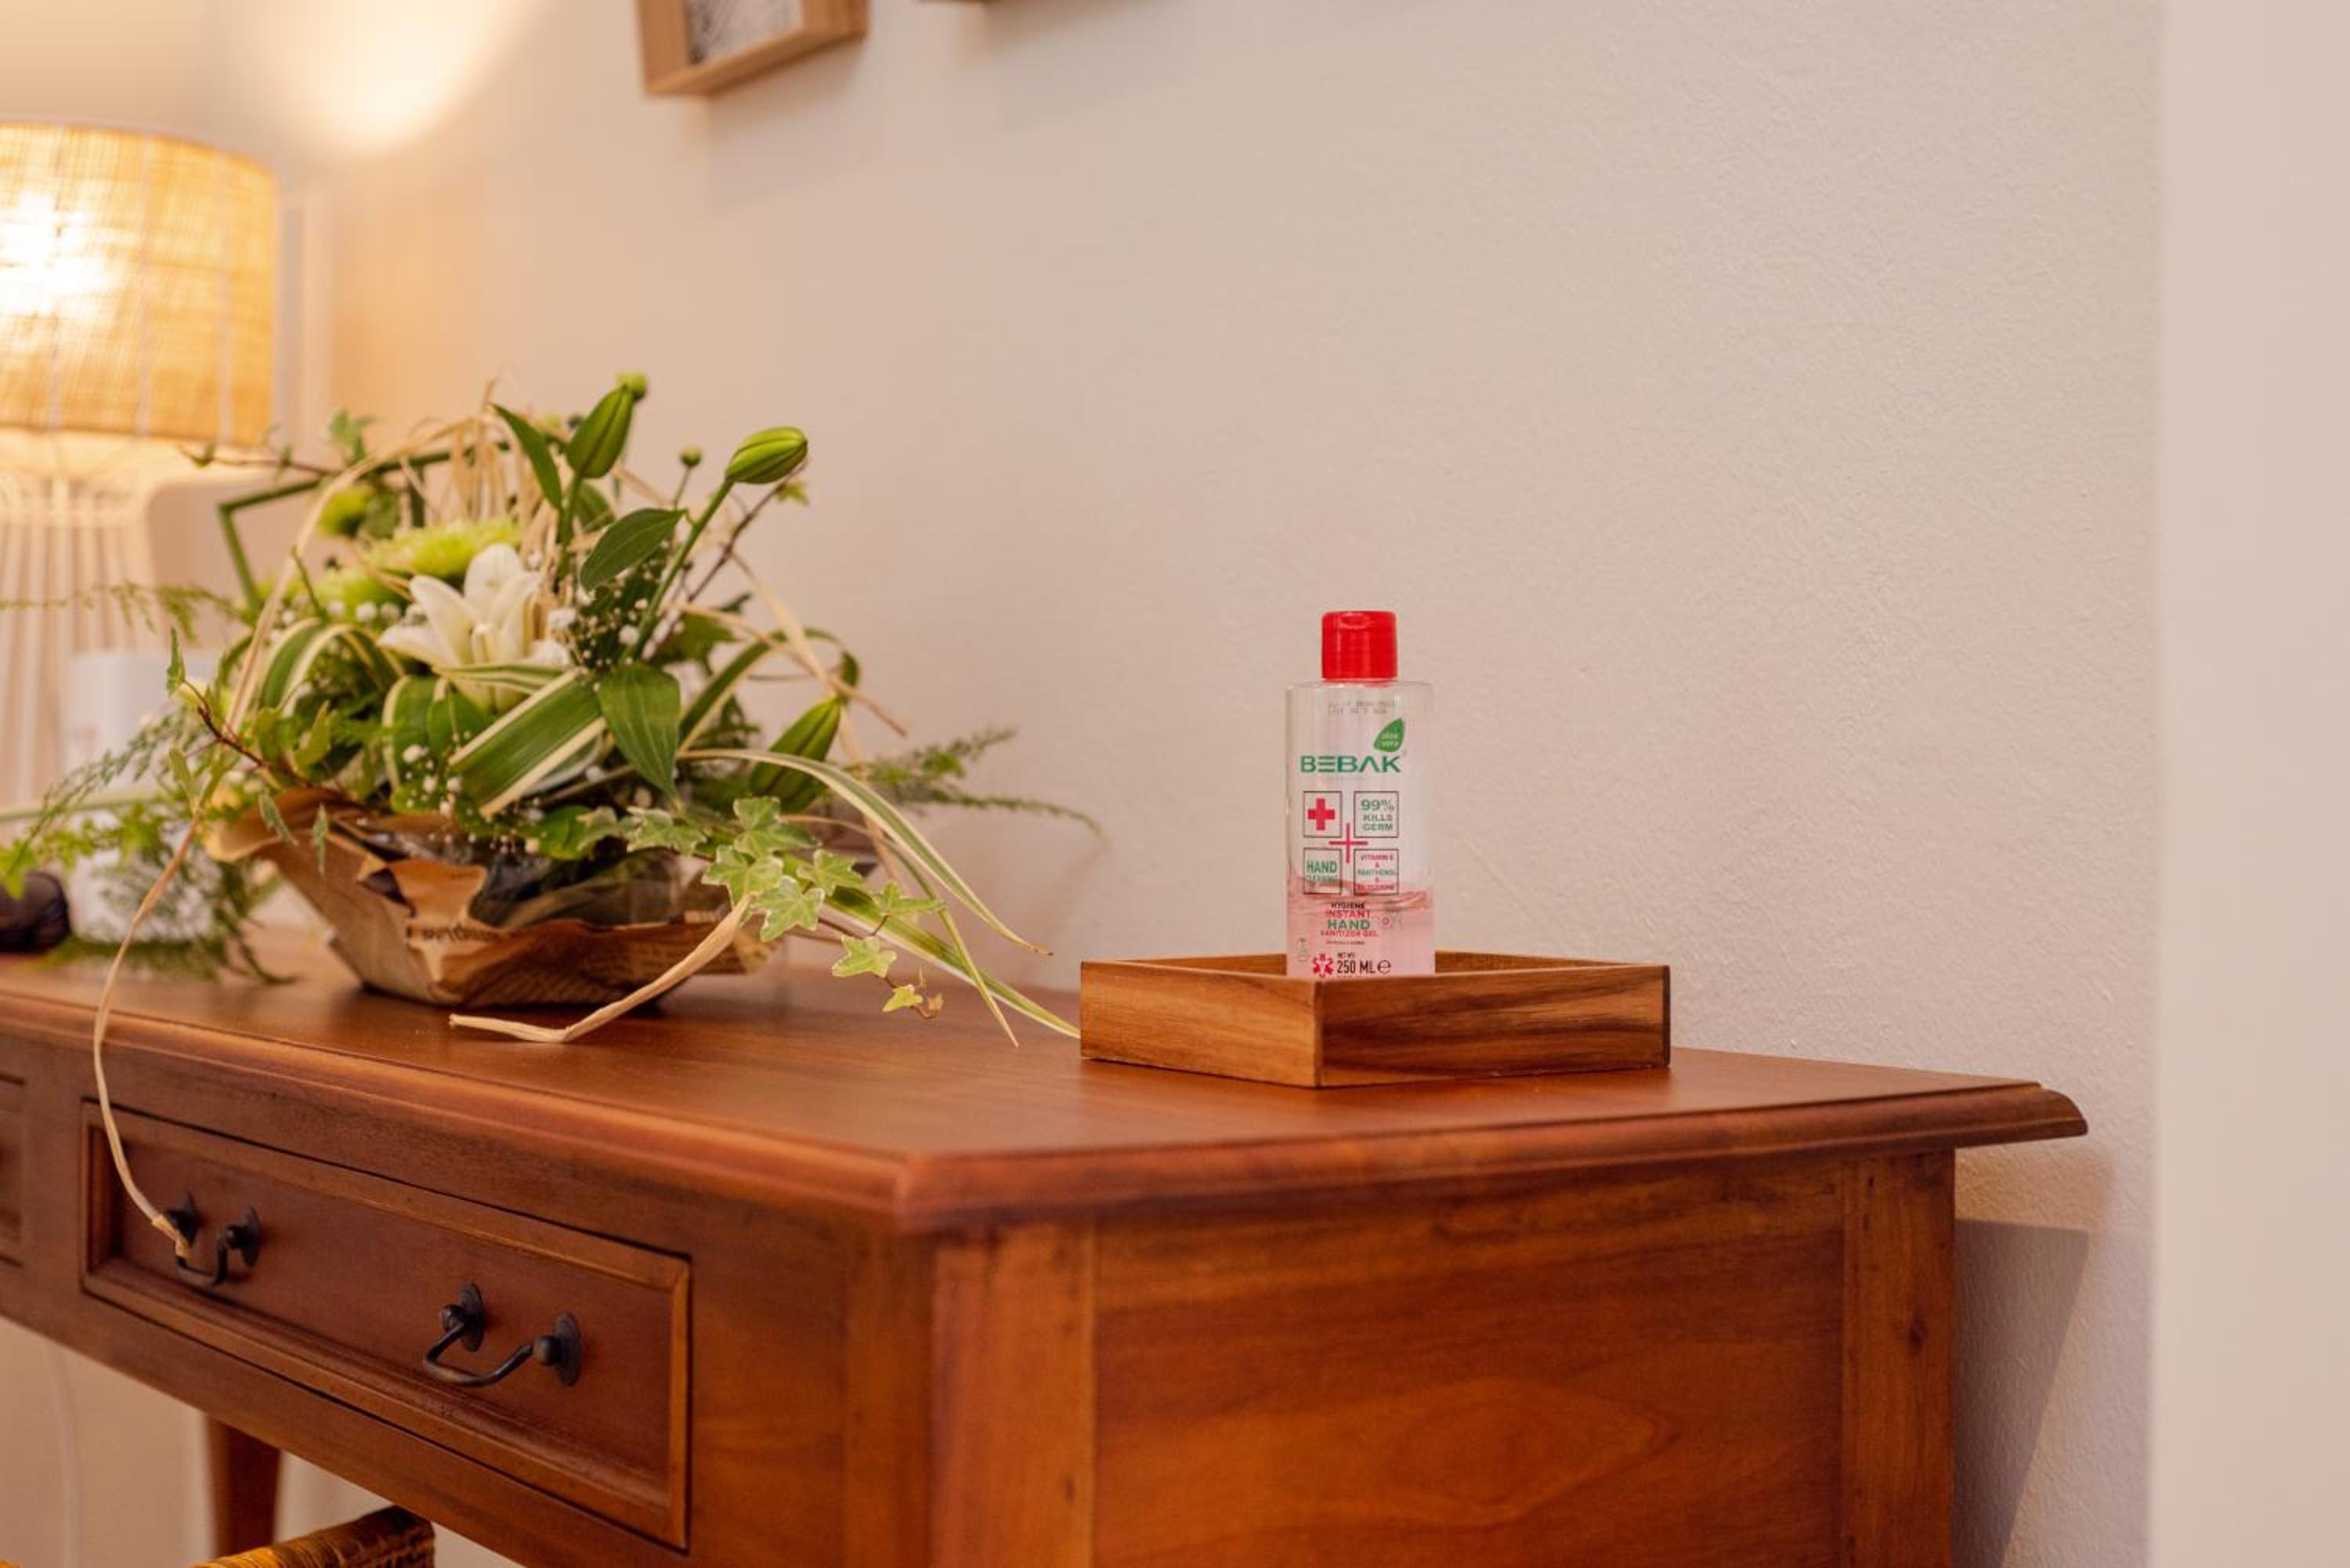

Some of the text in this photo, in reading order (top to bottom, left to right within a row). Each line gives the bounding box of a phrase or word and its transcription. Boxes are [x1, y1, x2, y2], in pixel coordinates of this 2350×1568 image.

[1300, 756, 1401, 772] BEBAK
[1361, 800, 1395, 811] 99%
[1306, 860, 1338, 873] HAND
[1328, 919, 1371, 930] HAND
[1337, 960, 1356, 974] 250
[1359, 960, 1376, 974] ML
